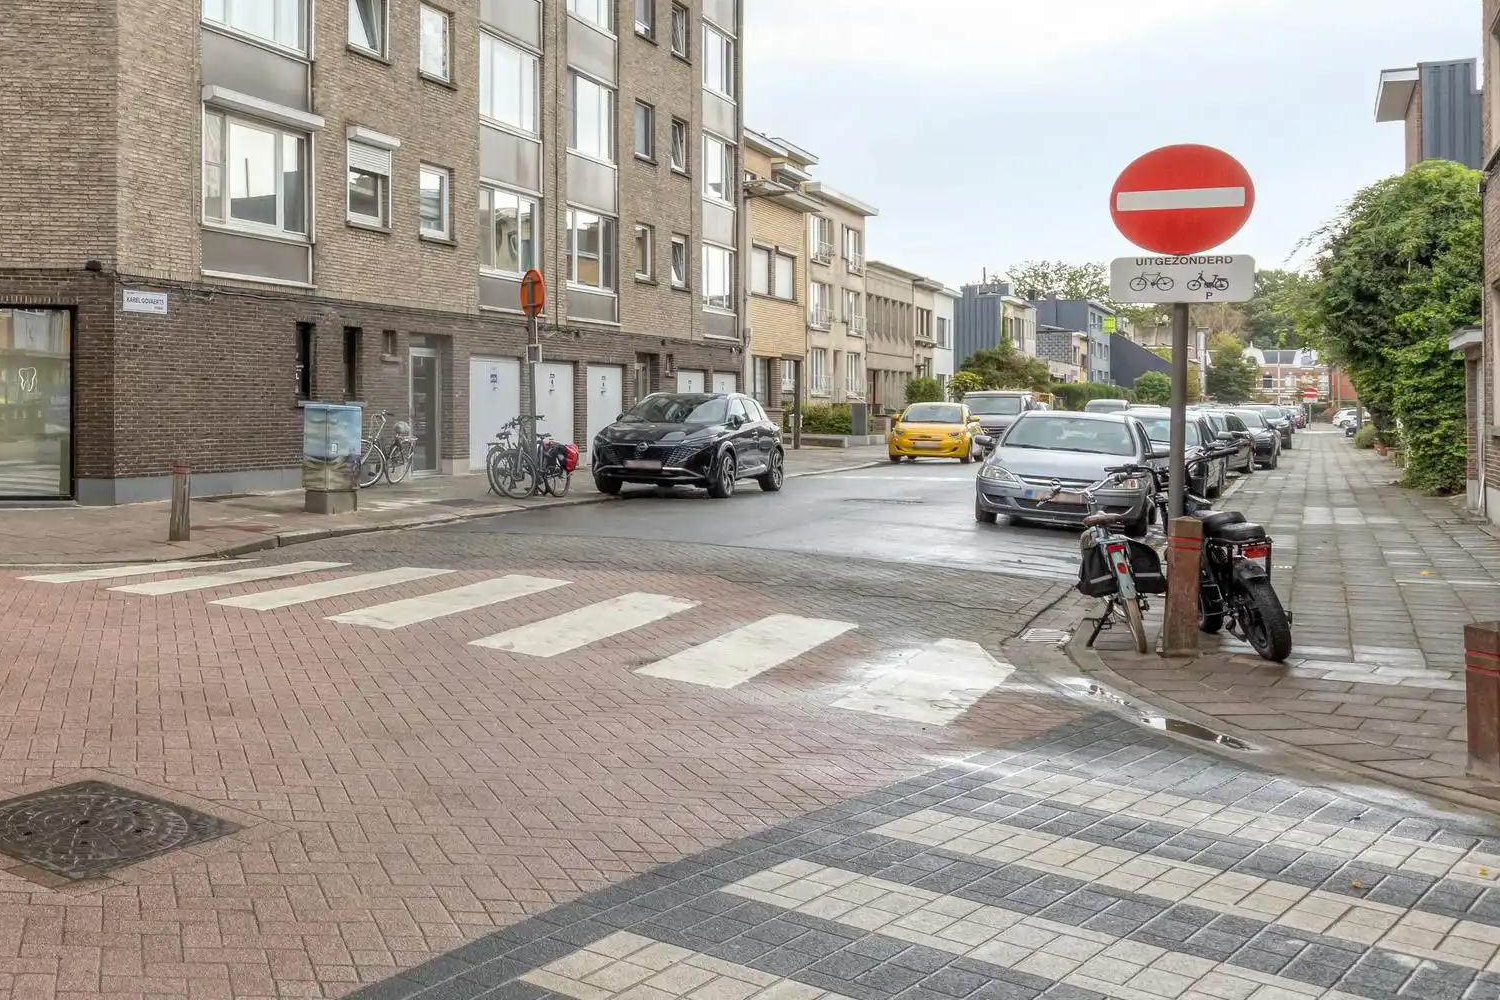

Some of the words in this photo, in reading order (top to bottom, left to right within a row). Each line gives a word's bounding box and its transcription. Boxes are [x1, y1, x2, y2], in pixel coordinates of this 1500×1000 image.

[1136, 256, 1233, 266] UITGEZONDERD
[126, 296, 141, 304] KAREL
[1206, 292, 1213, 300] P
